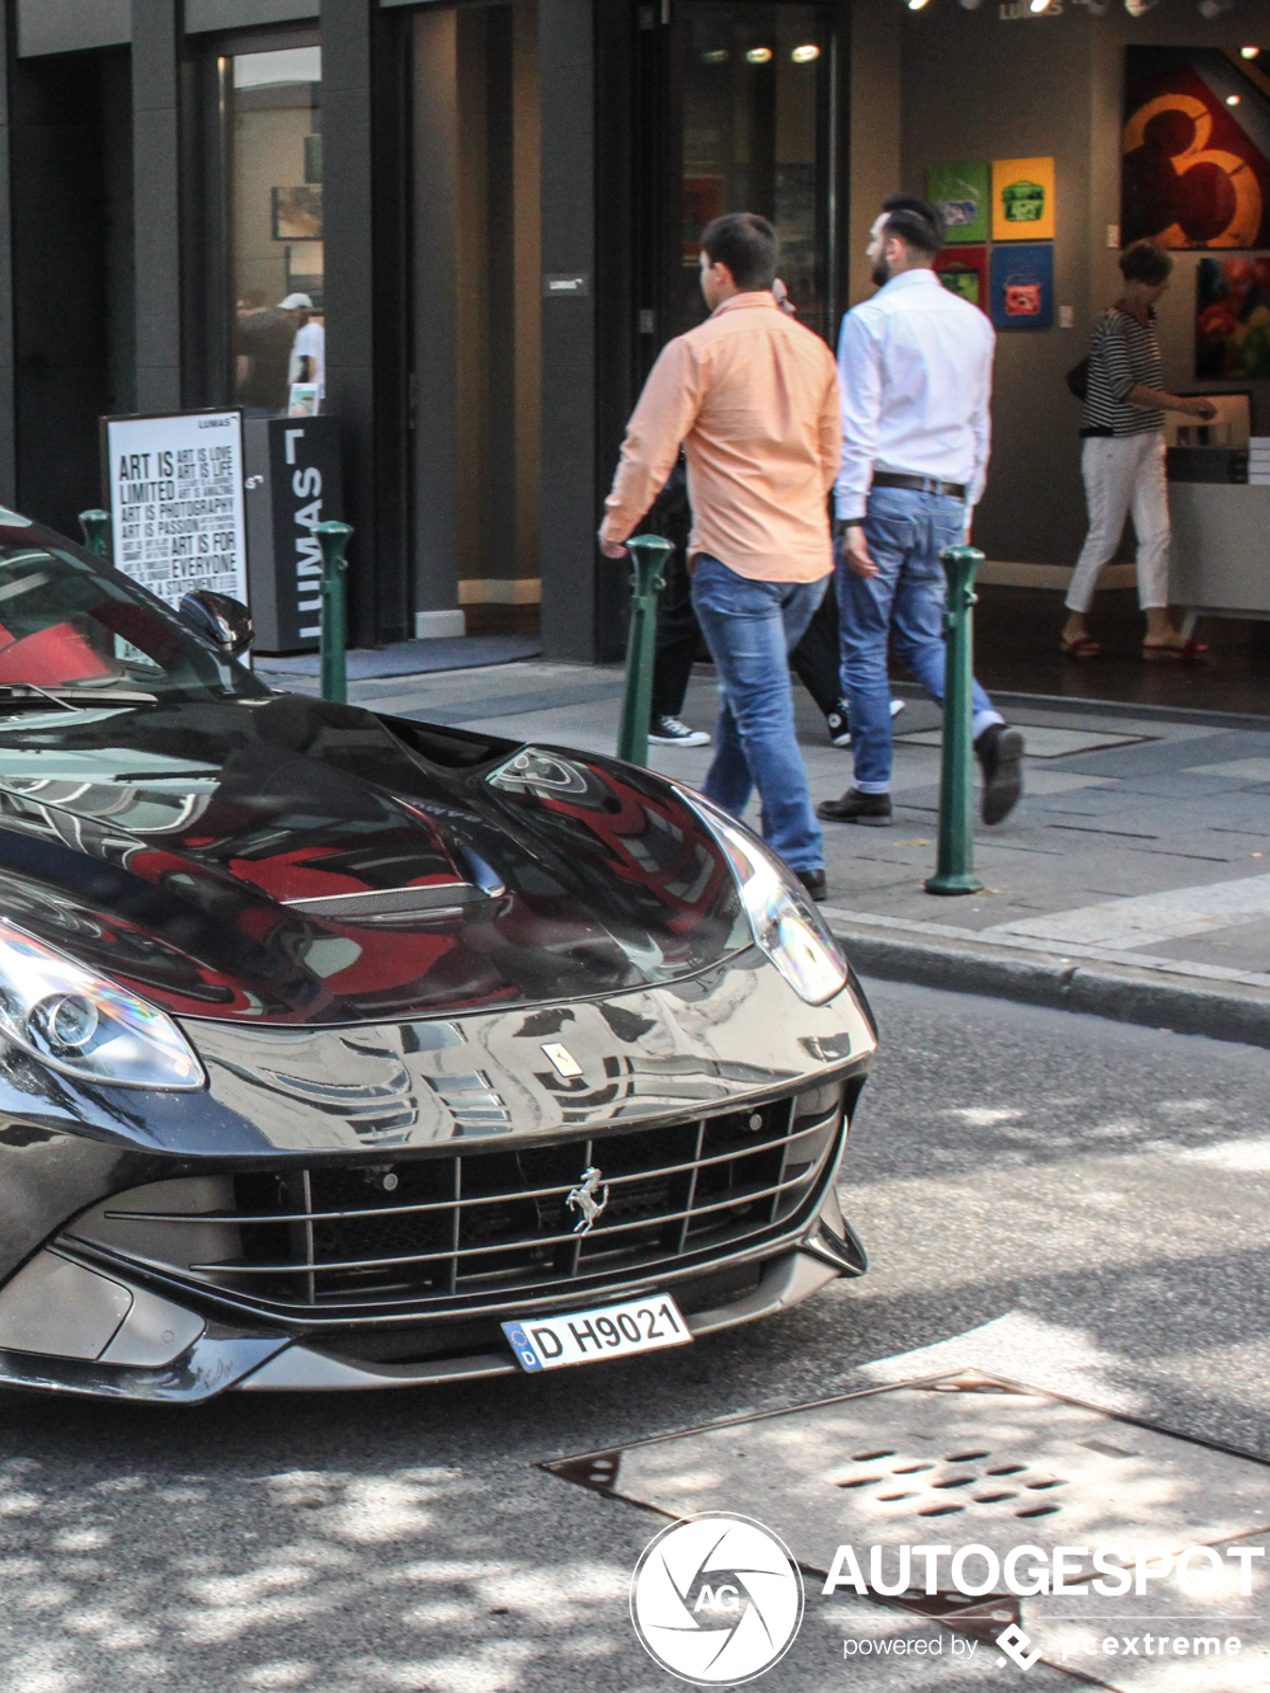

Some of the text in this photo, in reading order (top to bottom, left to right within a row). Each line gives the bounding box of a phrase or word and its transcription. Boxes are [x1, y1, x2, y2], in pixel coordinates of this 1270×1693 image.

[198, 419, 231, 429] LUMAS
[119, 450, 174, 481] ART IS
[177, 449, 194, 463] ART
[197, 447, 207, 462] IS
[177, 460, 232, 479] ART IS LIFE
[119, 480, 175, 505] LIMITED
[121, 506, 141, 523] ART
[145, 504, 155, 521] IS
[159, 498, 234, 520] PHOTOGRAPHY
[122, 523, 140, 539] ART
[145, 522, 154, 537] IS
[158, 519, 199, 536] PASSION
[172, 536, 194, 556] ART
[198, 534, 209, 553] IS
[213, 531, 236, 552] FOR
[173, 553, 236, 578] EVERYONE
[531, 1303, 681, 1359] D H9021
[521, 1351, 537, 1366] D
